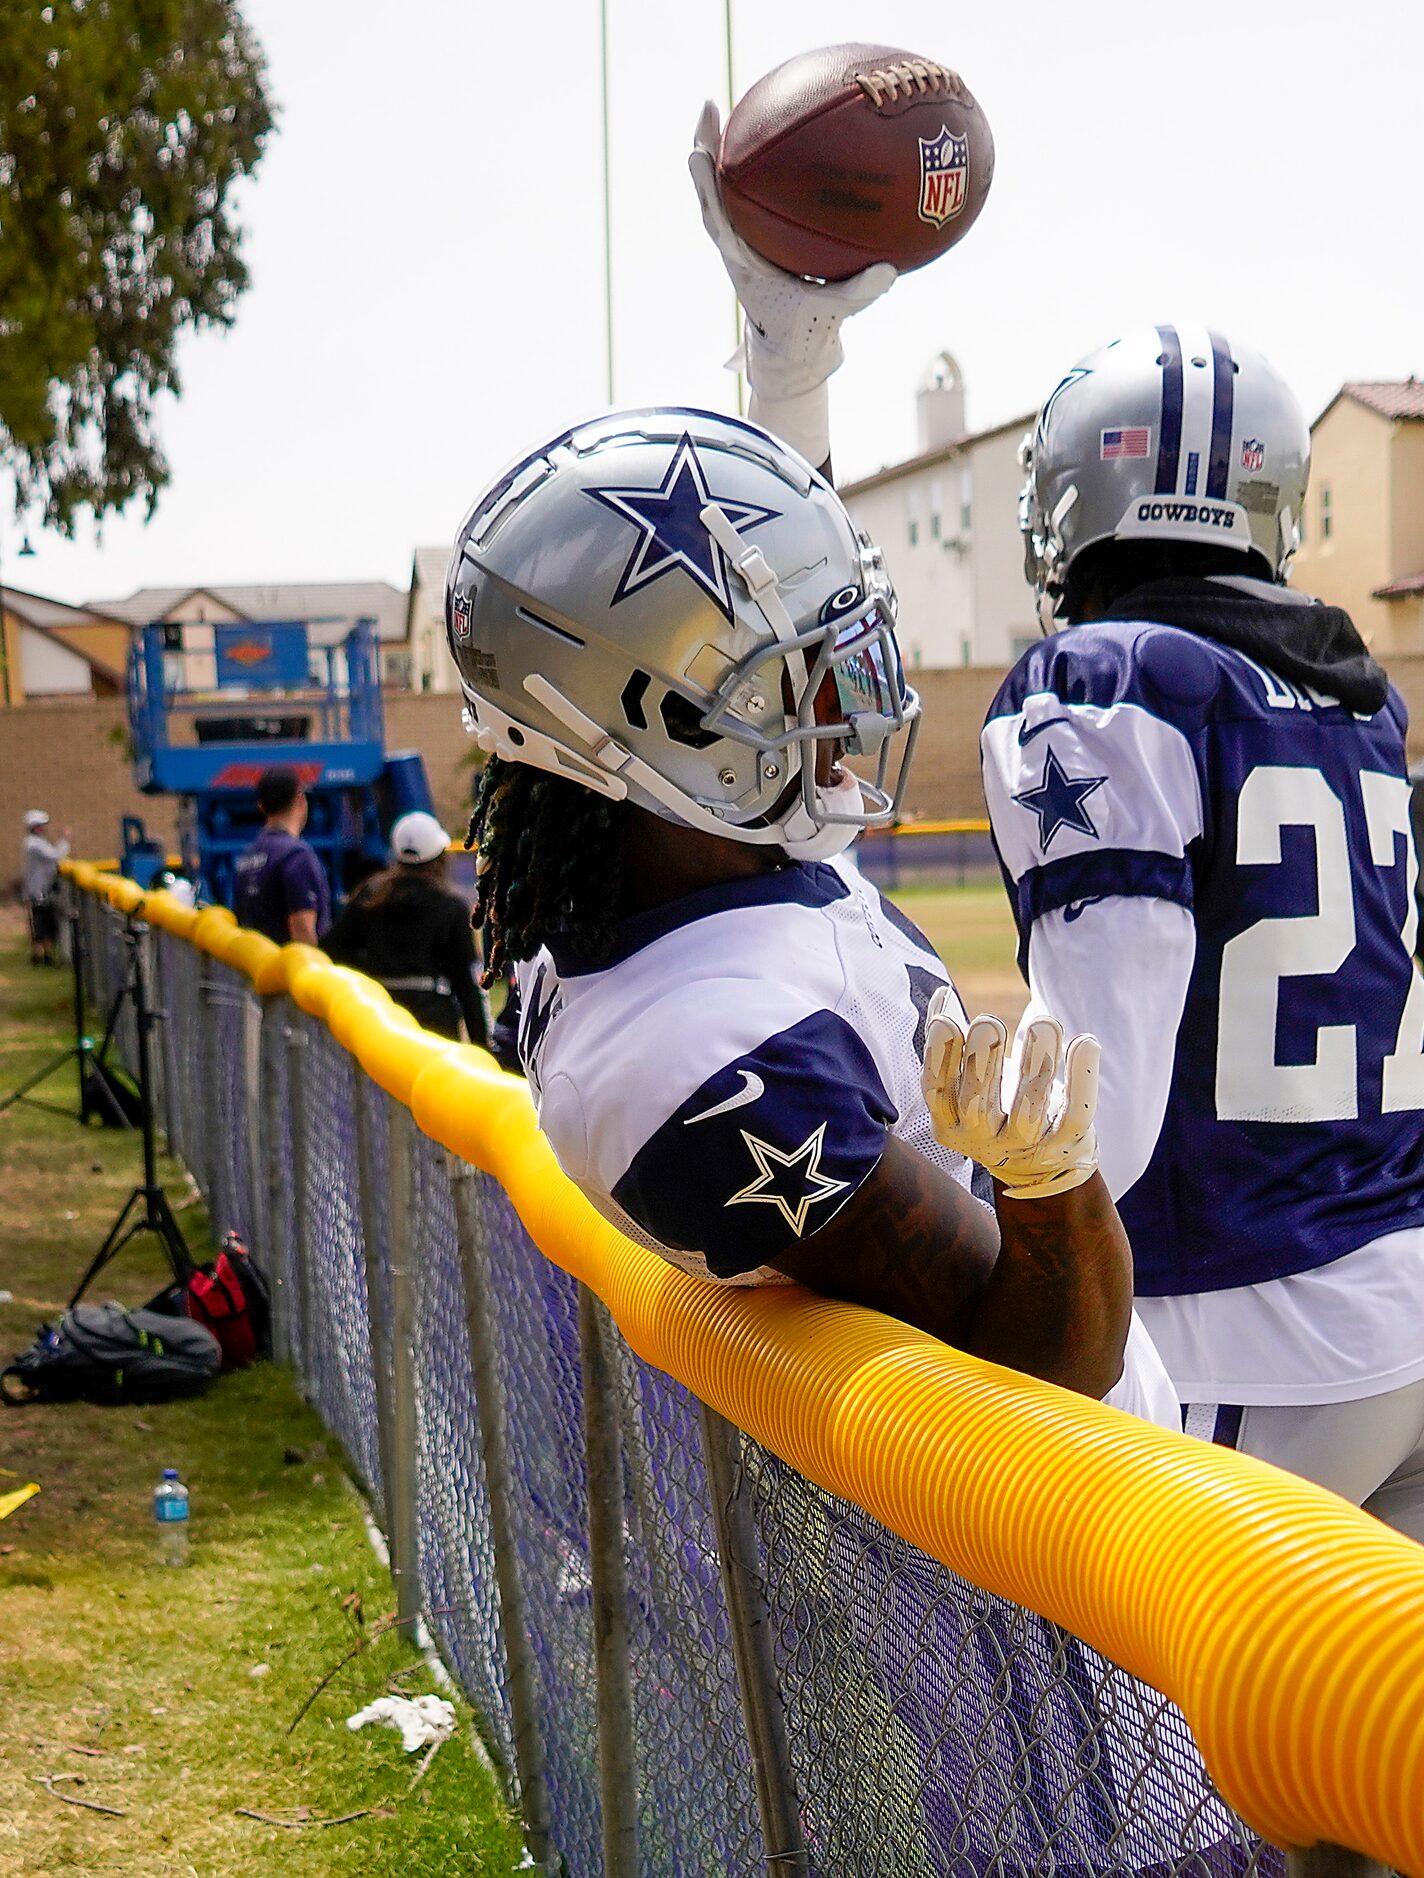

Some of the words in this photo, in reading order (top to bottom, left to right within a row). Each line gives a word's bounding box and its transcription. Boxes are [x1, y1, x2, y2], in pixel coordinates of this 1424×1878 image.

[925, 171, 963, 215] NFL
[1242, 451, 1263, 469] NFL
[1138, 504, 1235, 528] COWBOYS
